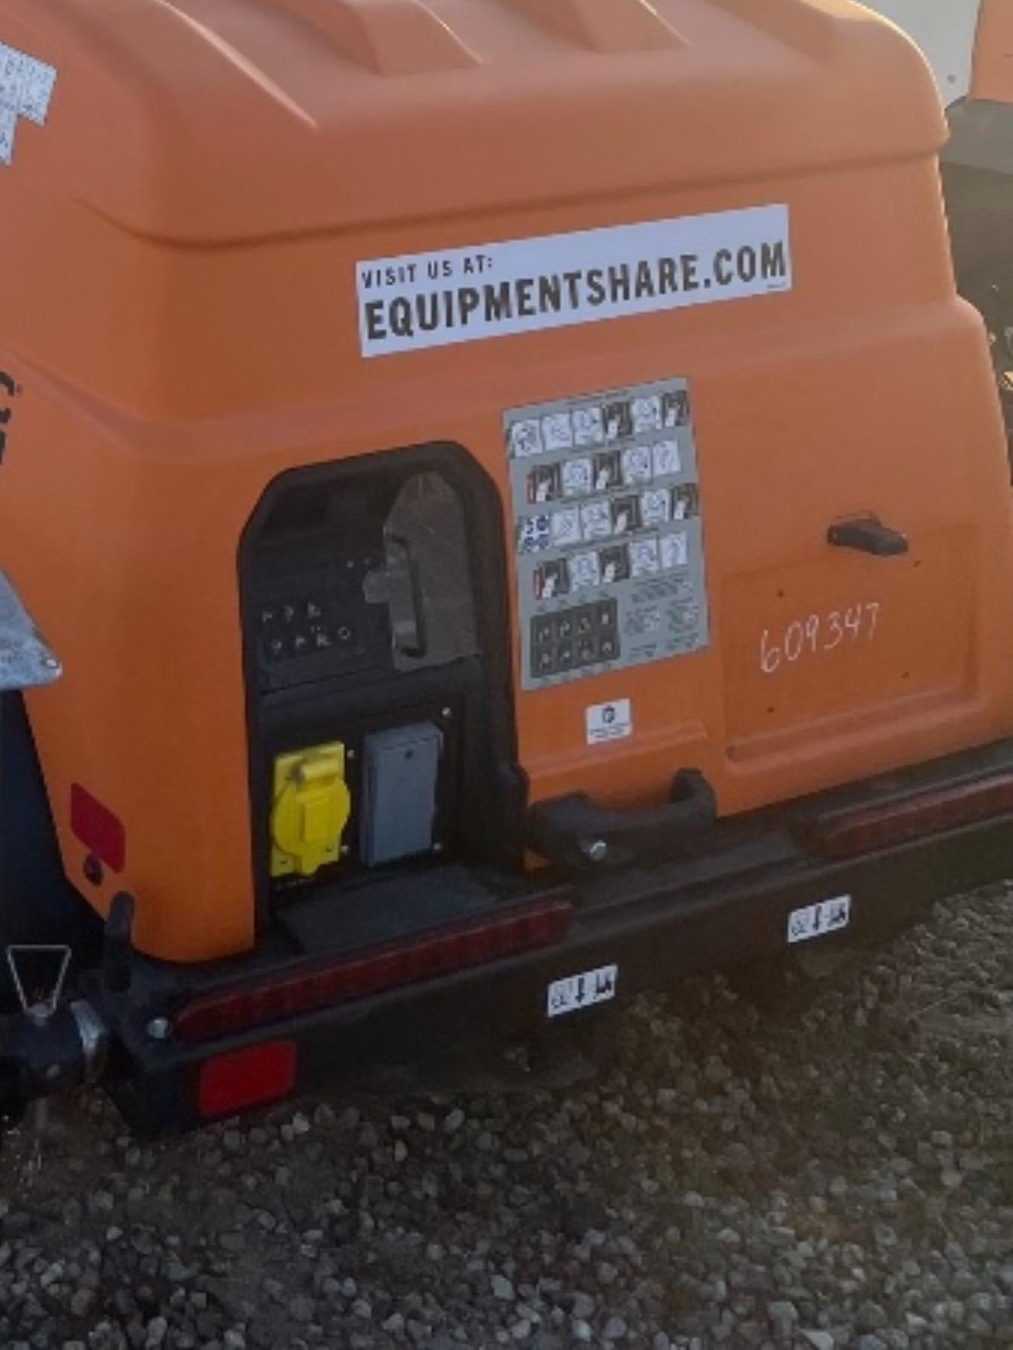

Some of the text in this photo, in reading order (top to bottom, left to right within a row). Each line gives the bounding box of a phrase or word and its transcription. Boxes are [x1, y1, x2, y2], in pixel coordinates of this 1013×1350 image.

[362, 254, 493, 289] VISIT US AT:
[364, 241, 786, 340] EQUIPMENTSHARE.COM
[760, 602, 880, 673] 609347
